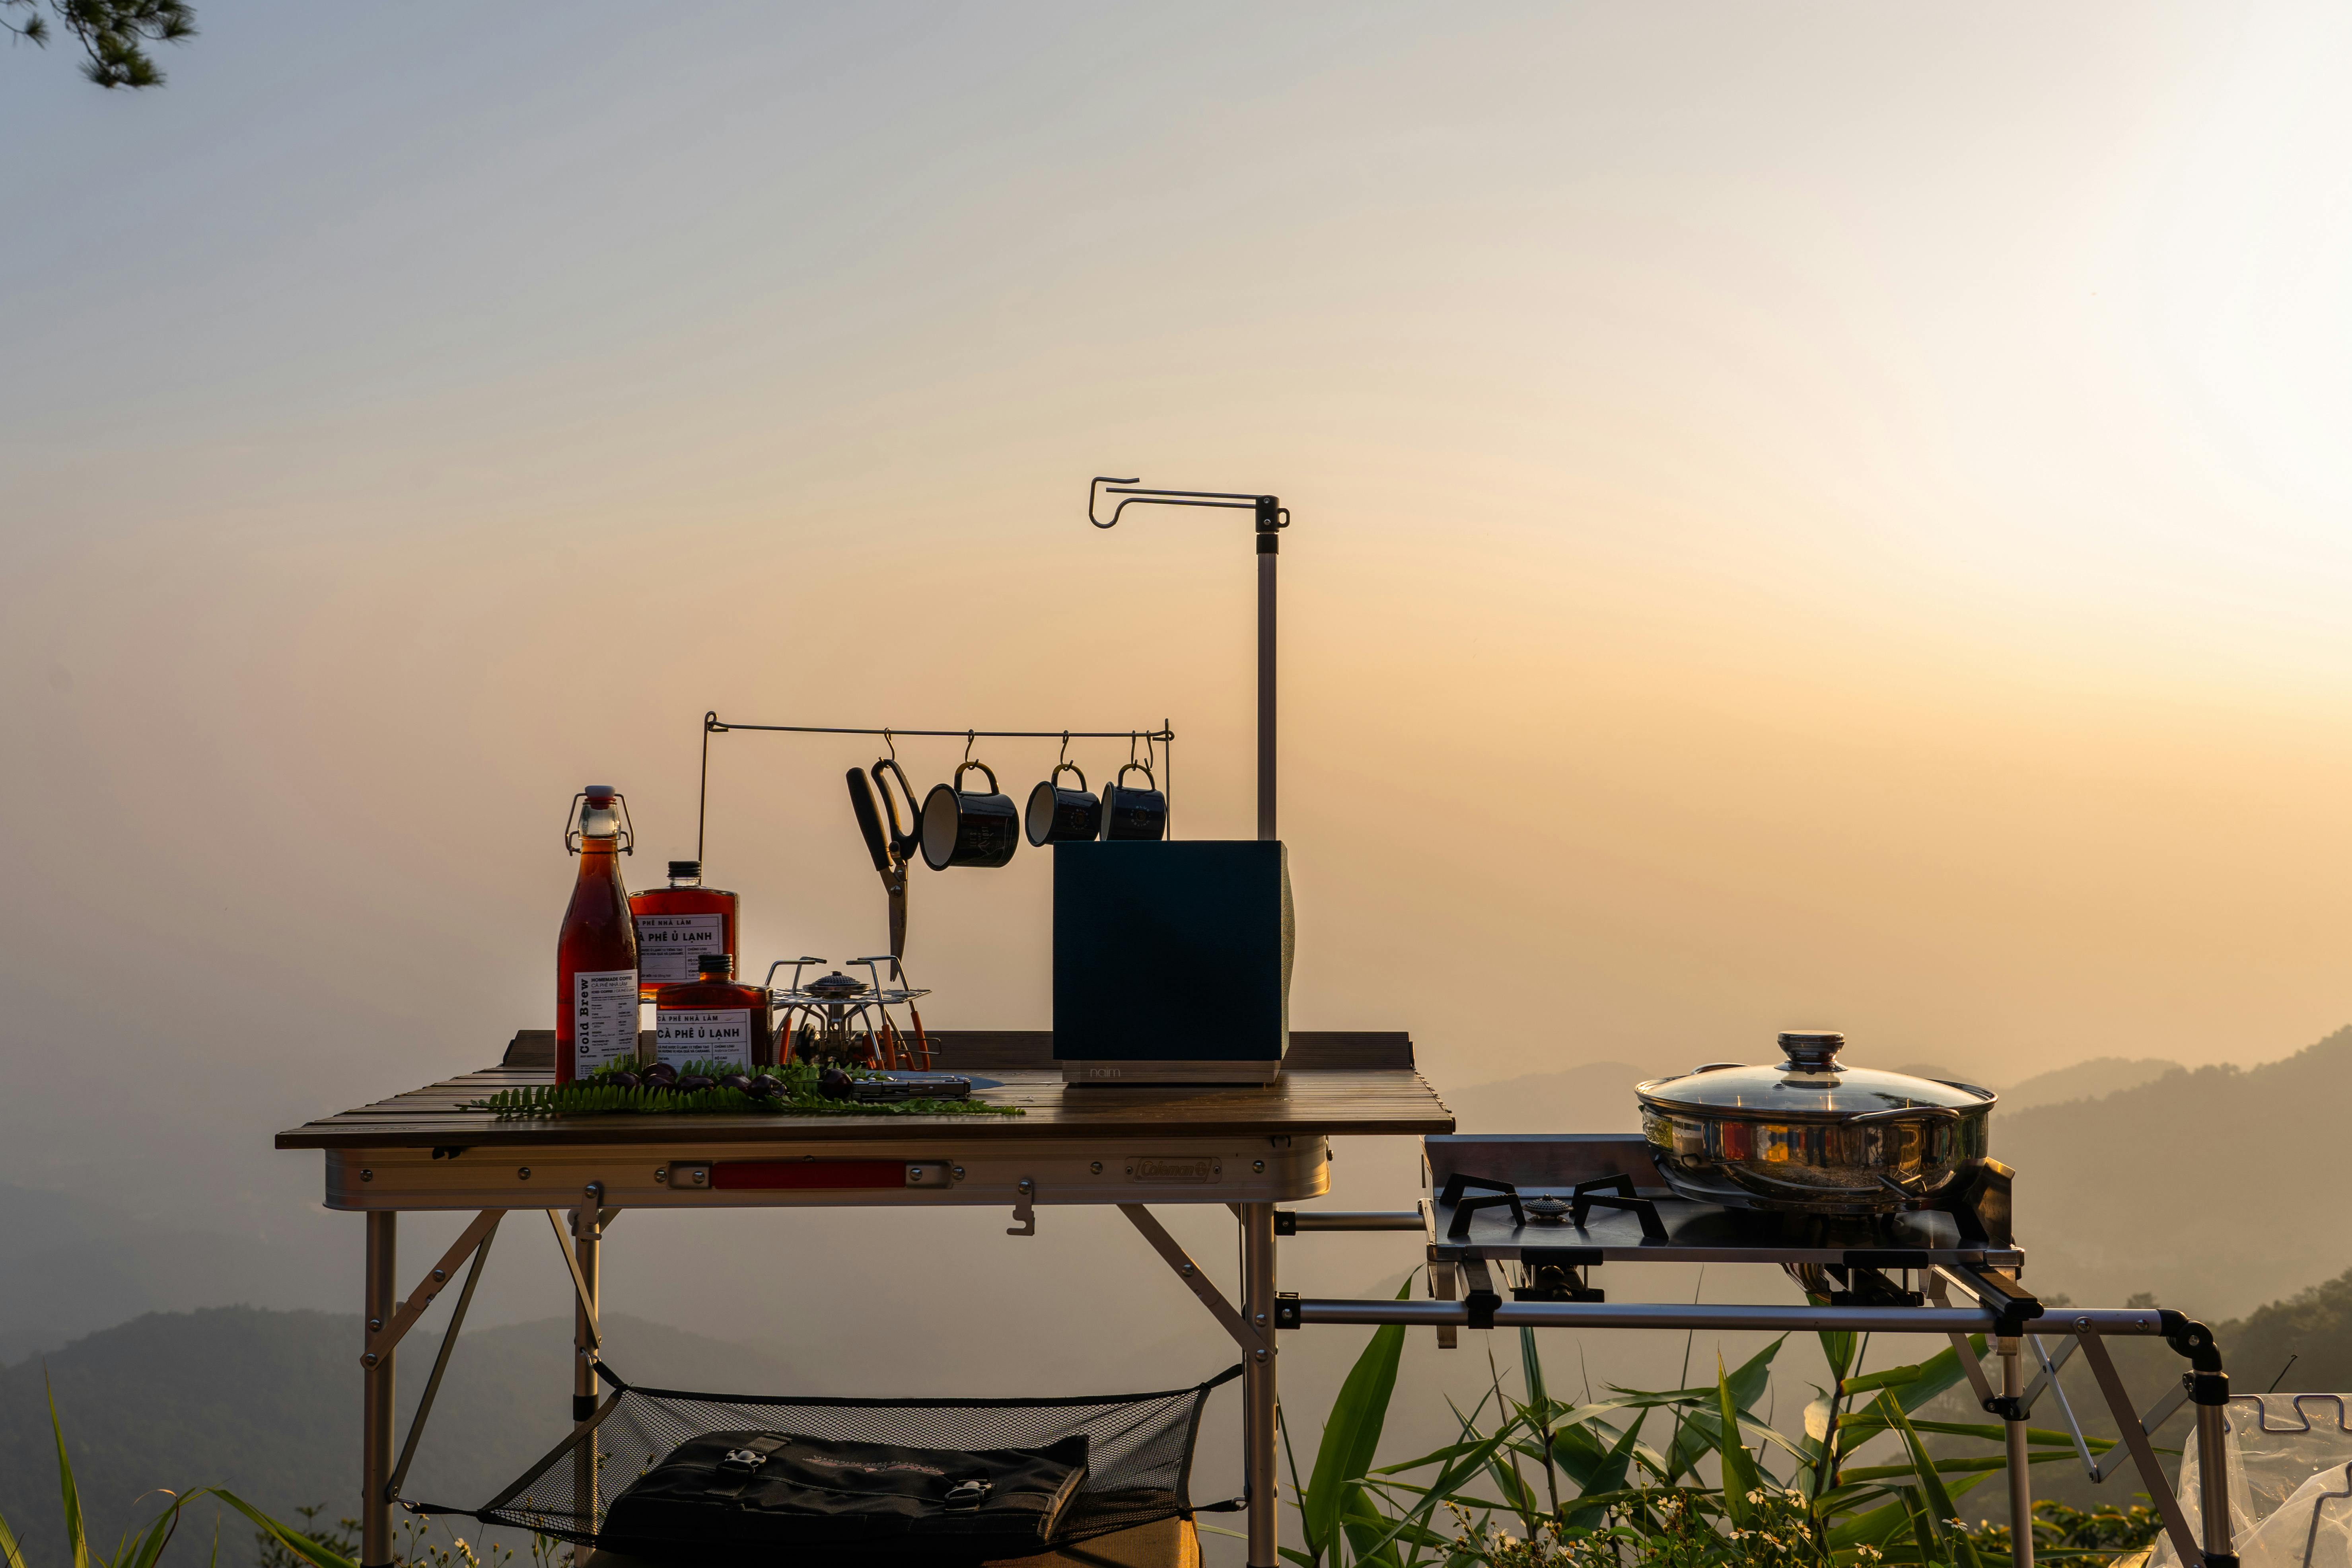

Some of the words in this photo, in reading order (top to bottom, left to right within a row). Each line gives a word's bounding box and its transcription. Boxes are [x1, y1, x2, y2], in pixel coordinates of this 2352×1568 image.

[640, 932, 645, 942] À
[649, 931, 667, 942] PHÊ
[672, 930, 678, 941] Ủ
[683, 932, 712, 943] LẠNH
[580, 979, 588, 1016] Brew
[580, 1022, 589, 1054] Cold
[658, 1027, 671, 1038] CÀ
[675, 1028, 694, 1038] PHÊ
[698, 1027, 704, 1038] Ủ
[710, 1029, 739, 1040] LẠNH
[1090, 1066, 1120, 1077] naim
[1141, 1161, 1194, 1176] Coleman
